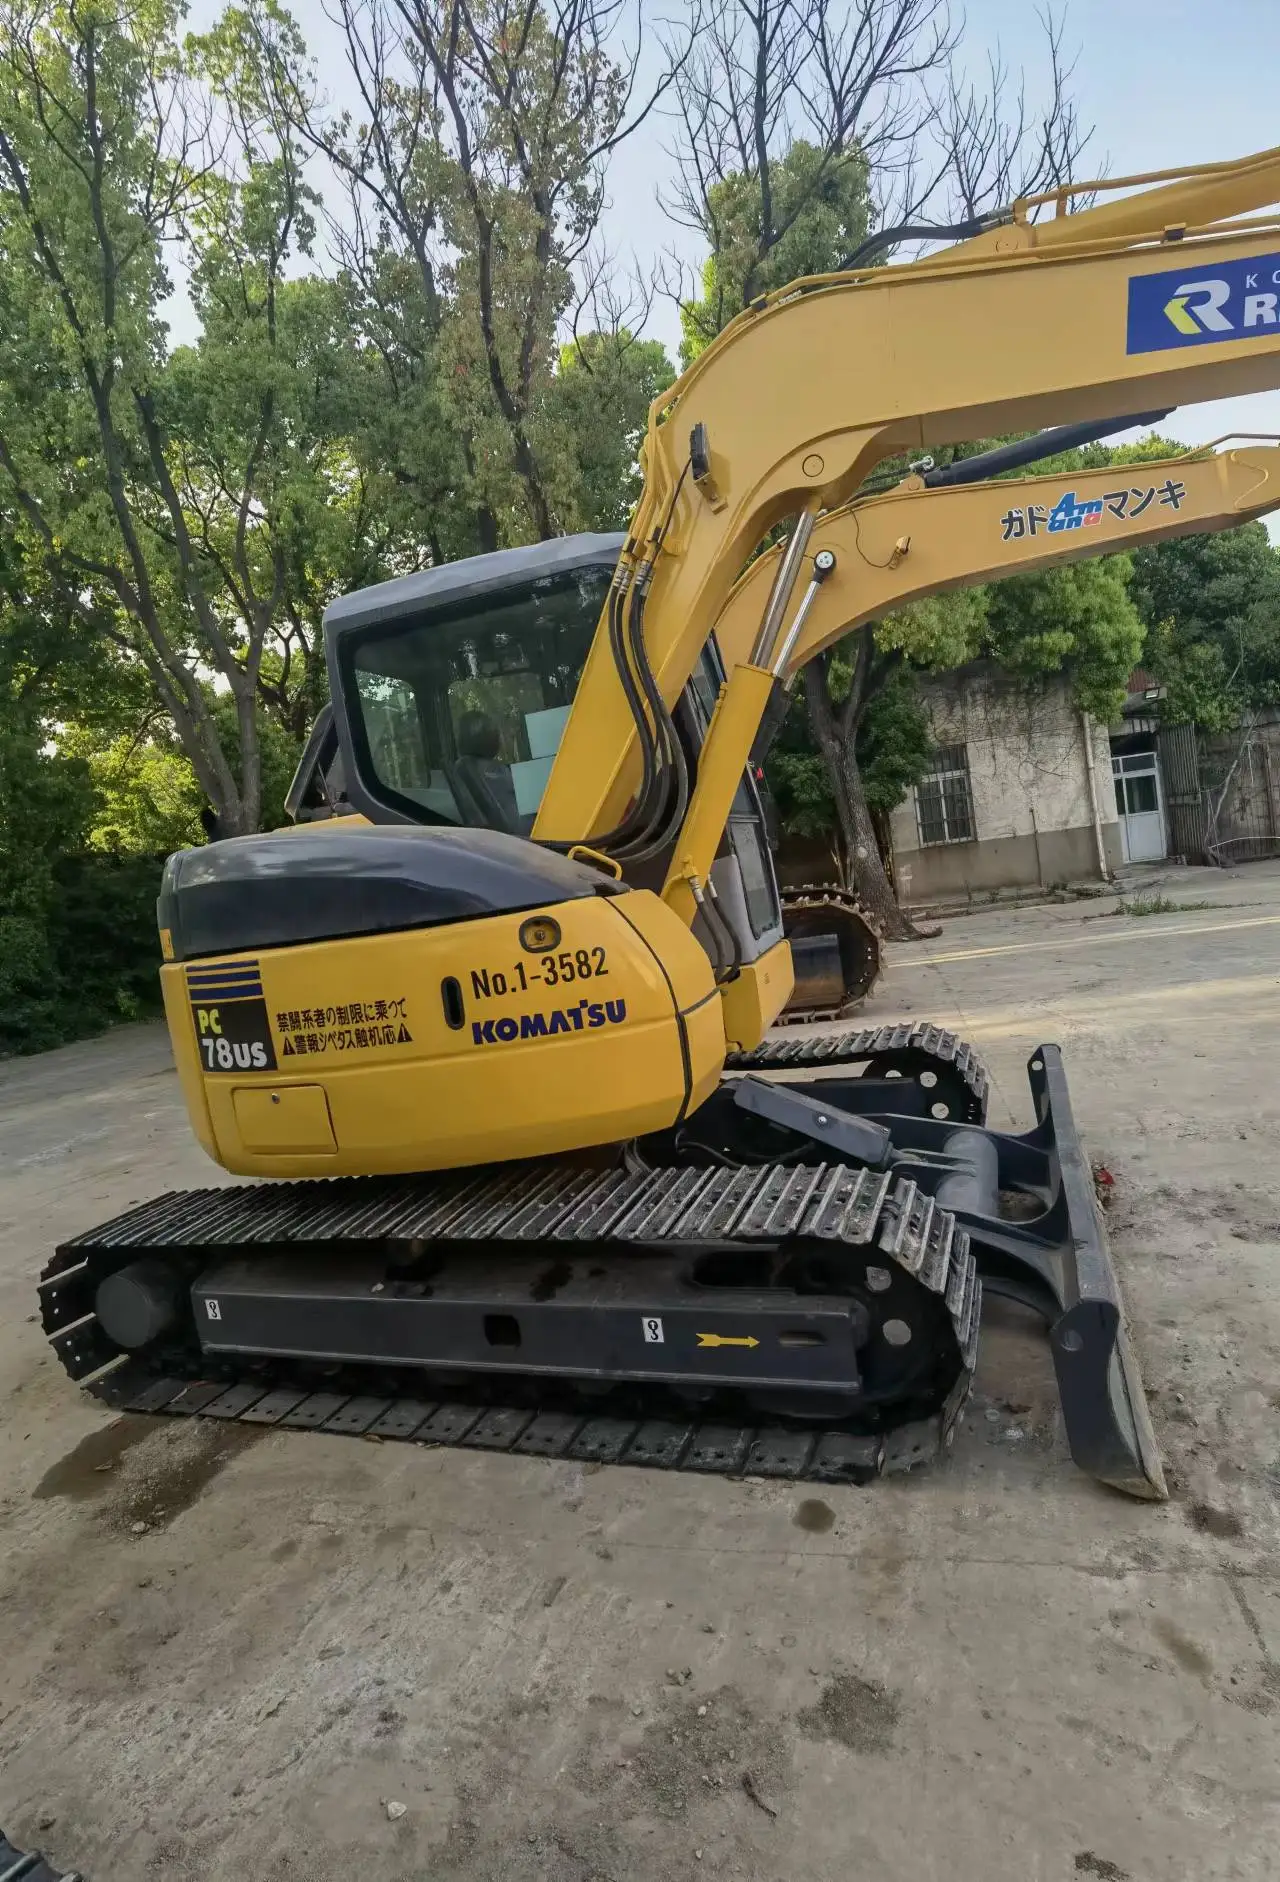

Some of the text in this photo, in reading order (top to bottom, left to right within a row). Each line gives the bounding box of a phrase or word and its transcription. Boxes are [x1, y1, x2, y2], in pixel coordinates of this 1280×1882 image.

[1244, 293, 1280, 327] R
[470, 946, 609, 999] No.1-3582
[197, 1008, 222, 1034] PC
[472, 999, 627, 1045] KOMATSU
